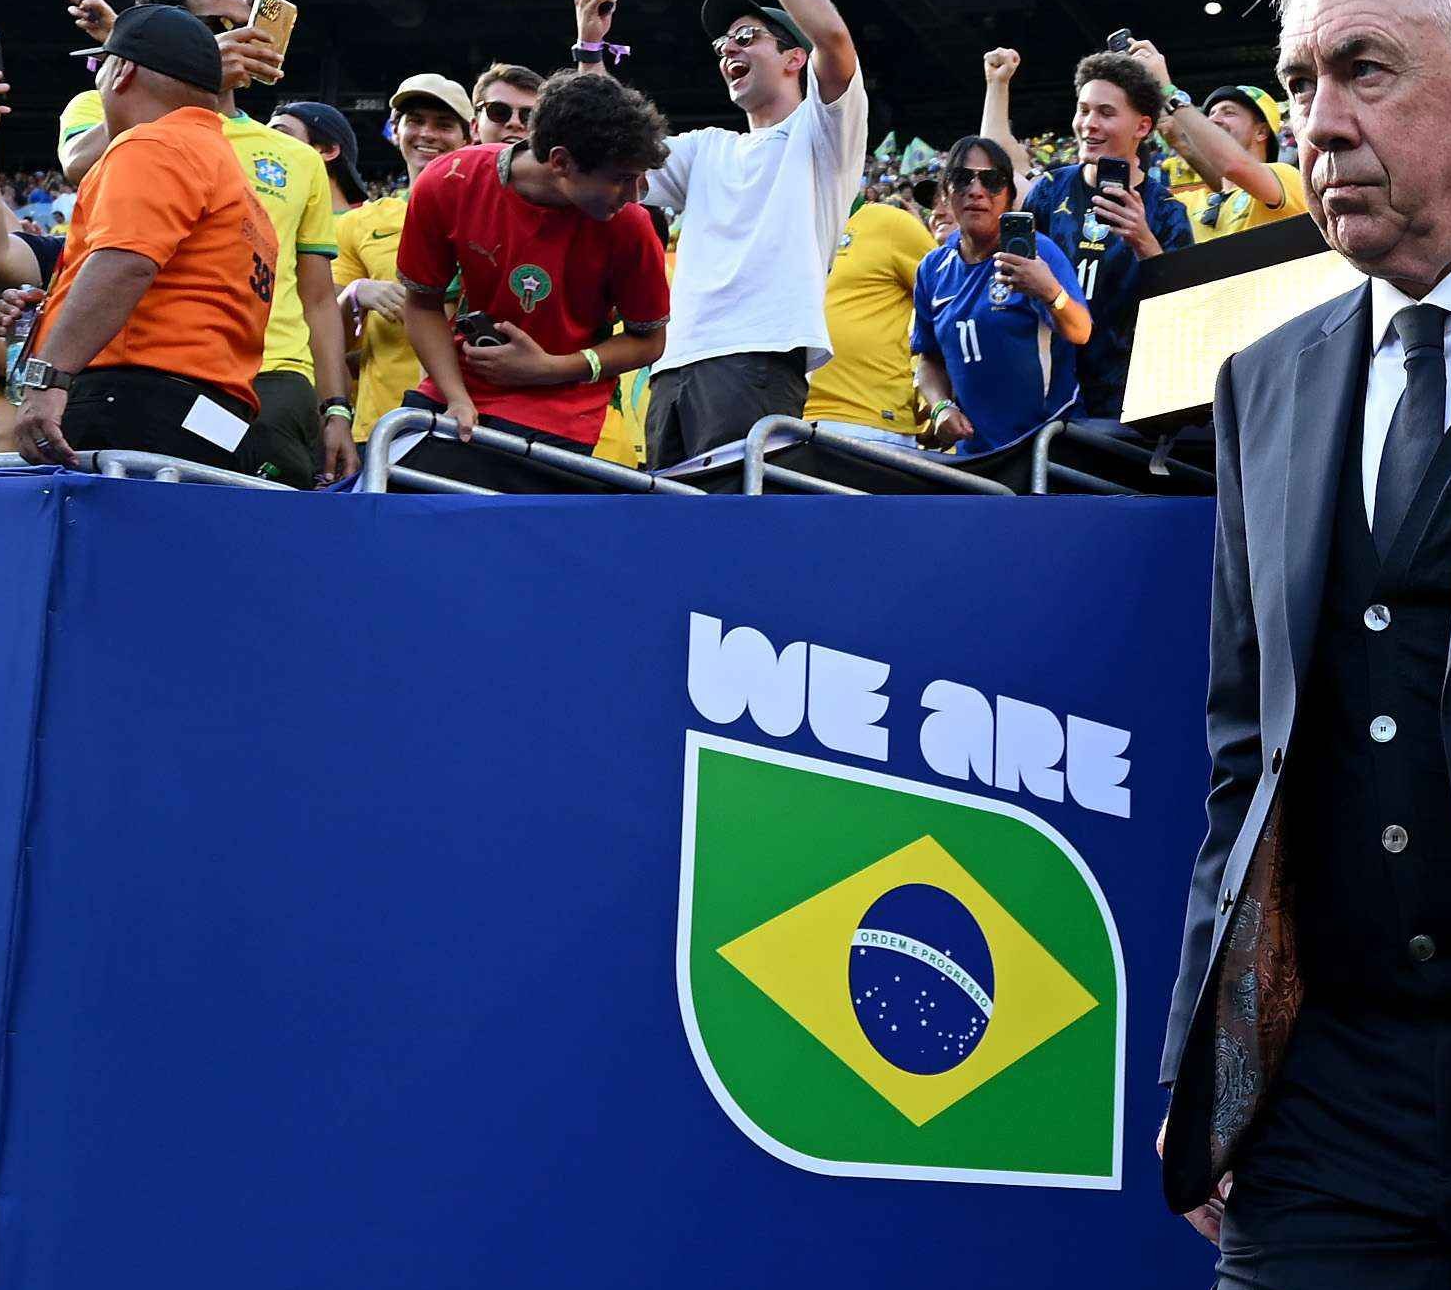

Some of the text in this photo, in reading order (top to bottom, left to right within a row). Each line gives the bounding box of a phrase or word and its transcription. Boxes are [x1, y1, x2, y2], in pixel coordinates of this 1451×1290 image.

[250, 251, 276, 303] 38
[1076, 258, 1099, 301] 11
[956, 318, 982, 364] 11
[687, 611, 891, 762] WE
[861, 932, 907, 950] ORDEM
[920, 949, 989, 1008] PROGRESSO
